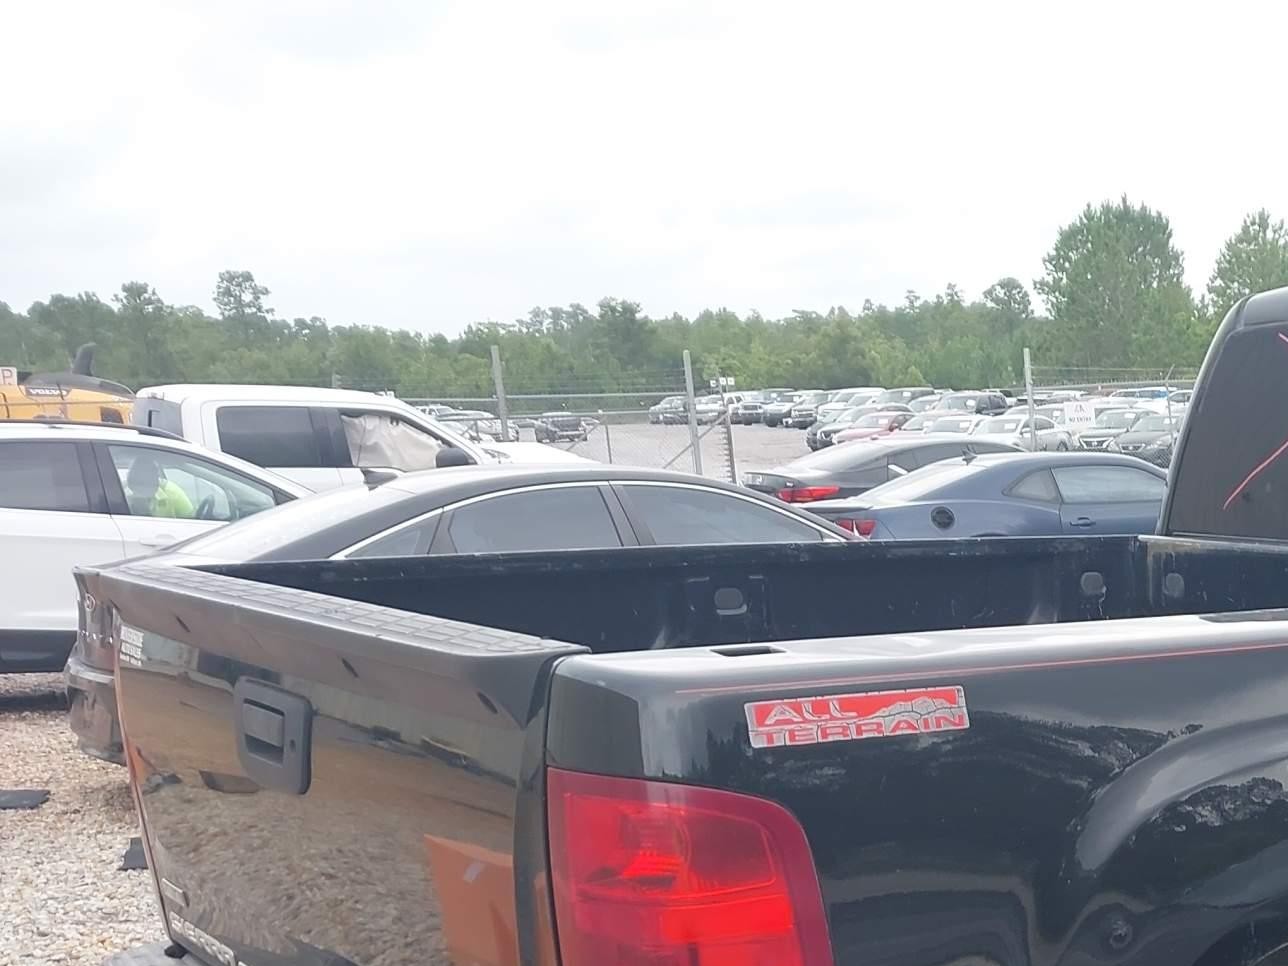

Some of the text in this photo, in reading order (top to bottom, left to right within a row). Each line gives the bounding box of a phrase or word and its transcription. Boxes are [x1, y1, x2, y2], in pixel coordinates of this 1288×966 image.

[29, 388, 68, 396] VOLVO
[765, 701, 858, 725] ALL
[753, 713, 964, 746] TERRAIN
